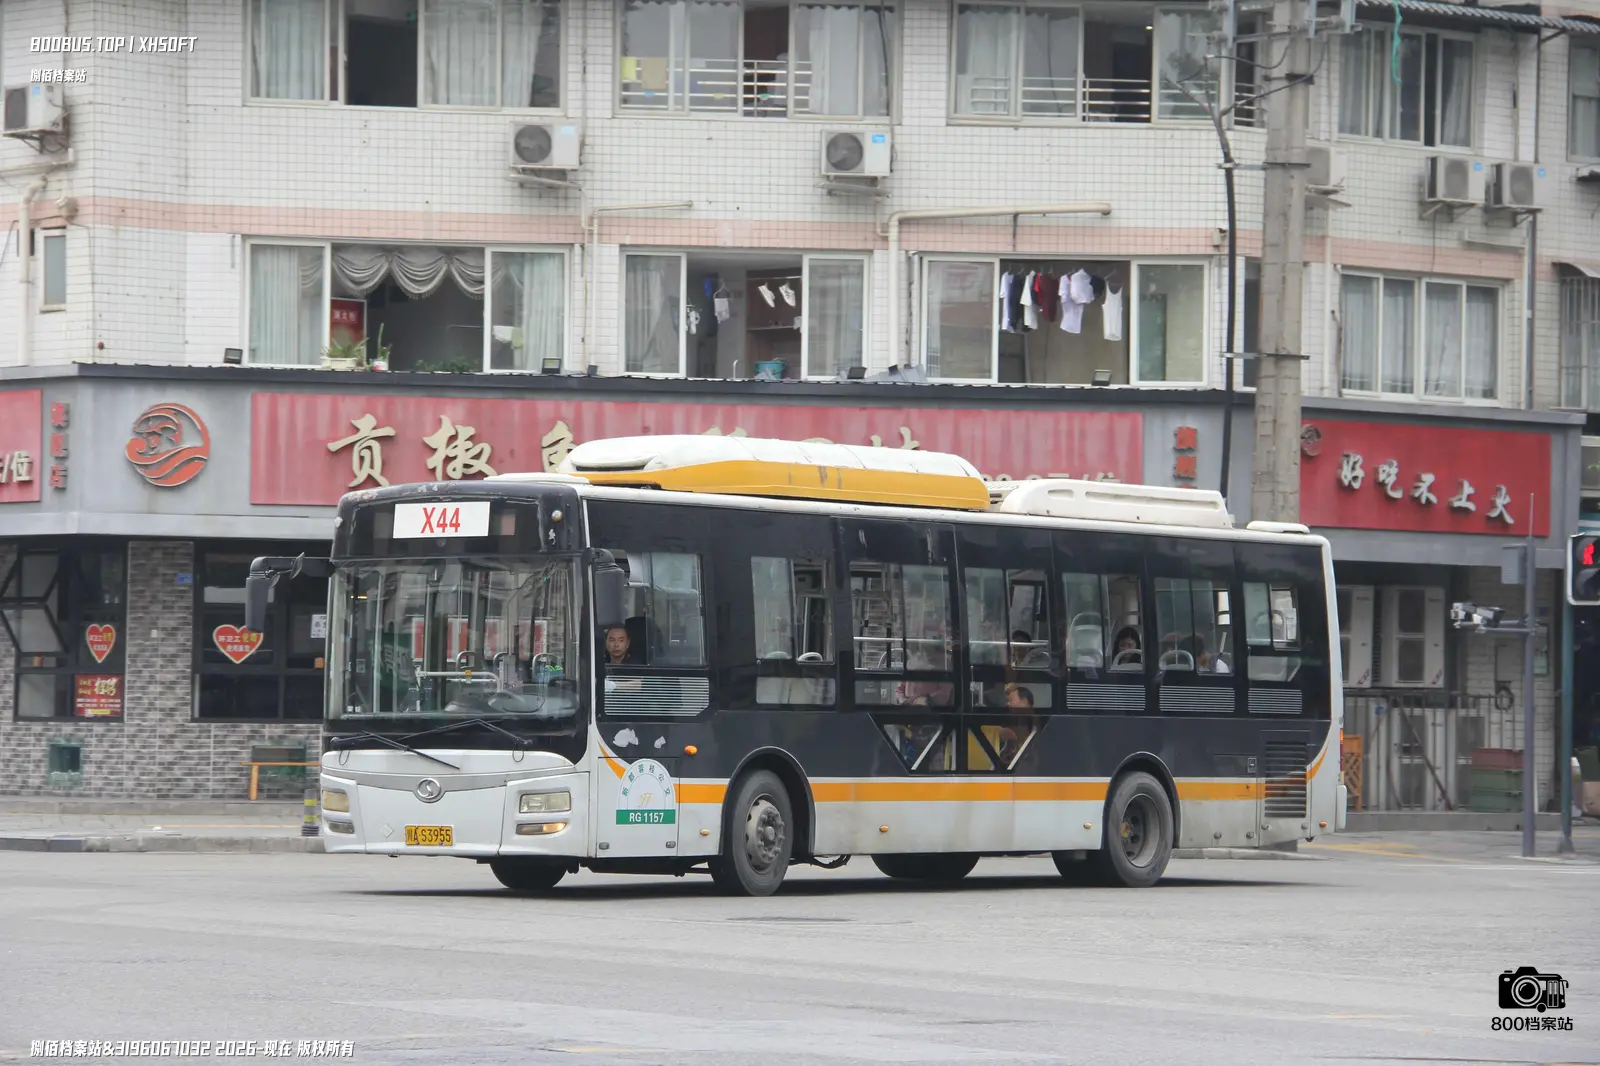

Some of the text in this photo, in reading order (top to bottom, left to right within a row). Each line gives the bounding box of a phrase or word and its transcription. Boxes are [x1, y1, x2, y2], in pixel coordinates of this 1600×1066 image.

[0, 450, 33, 483] /位
[1340, 452, 1515, 525] 好吃不上火
[420, 507, 461, 534] X44
[629, 812, 664, 823] RG 1157
